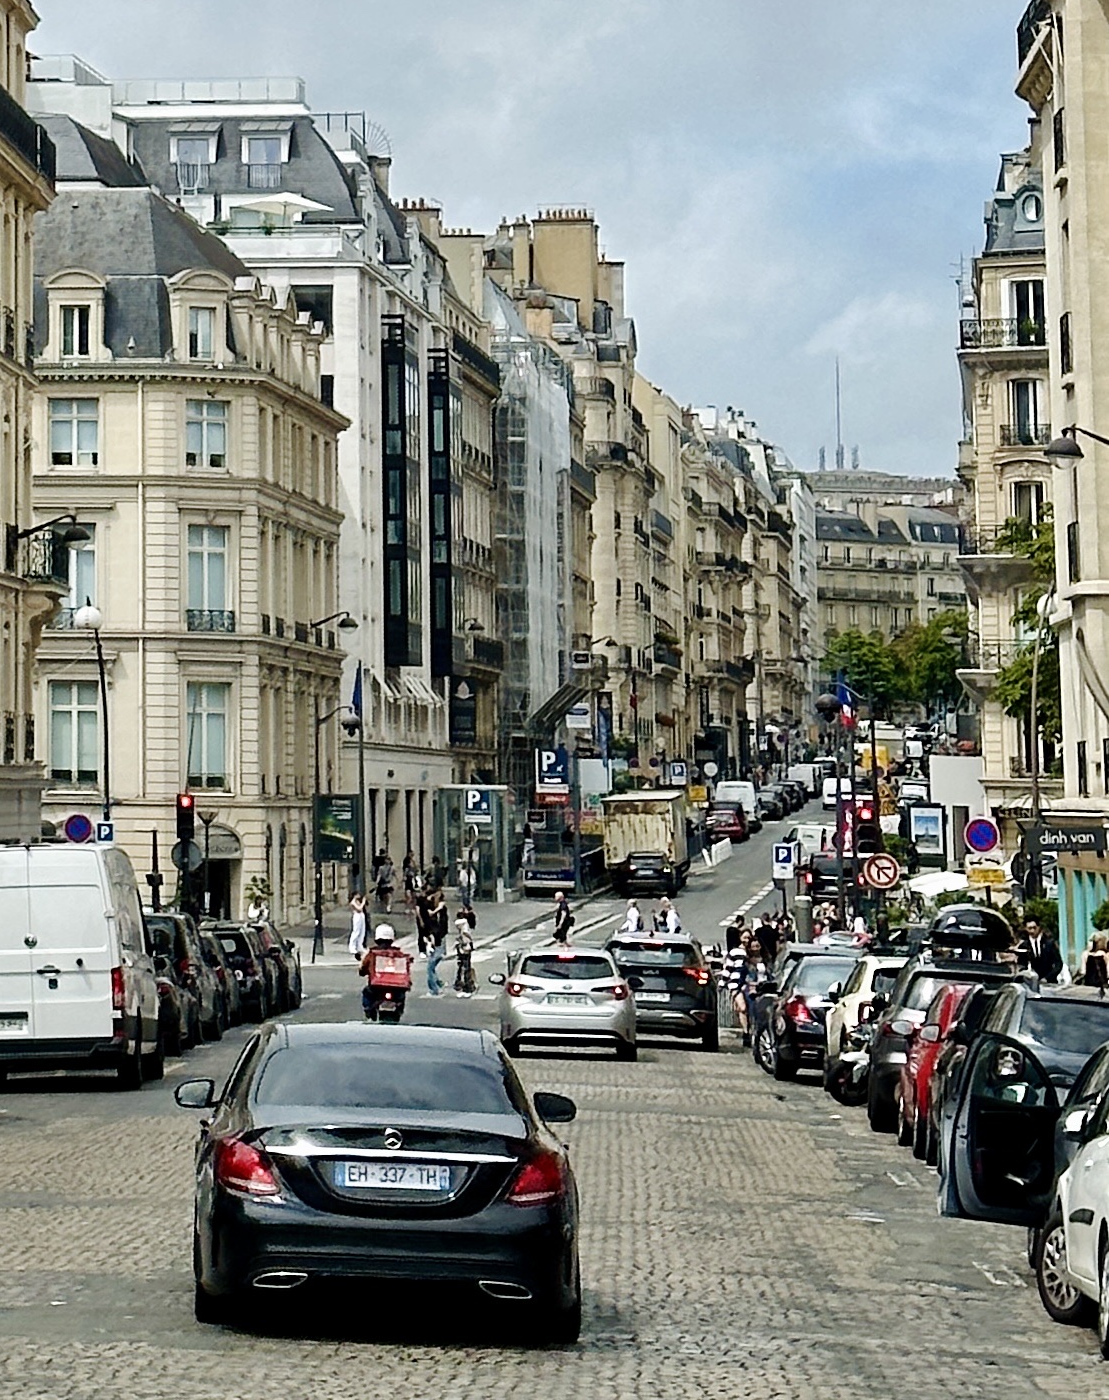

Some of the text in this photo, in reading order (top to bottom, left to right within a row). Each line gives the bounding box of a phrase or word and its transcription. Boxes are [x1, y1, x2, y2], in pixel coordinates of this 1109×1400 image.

[541, 751, 556, 772] P
[467, 790, 481, 810] P
[100, 825, 110, 839] P
[1039, 830, 1095, 845] dinh van
[778, 848, 788, 861] P
